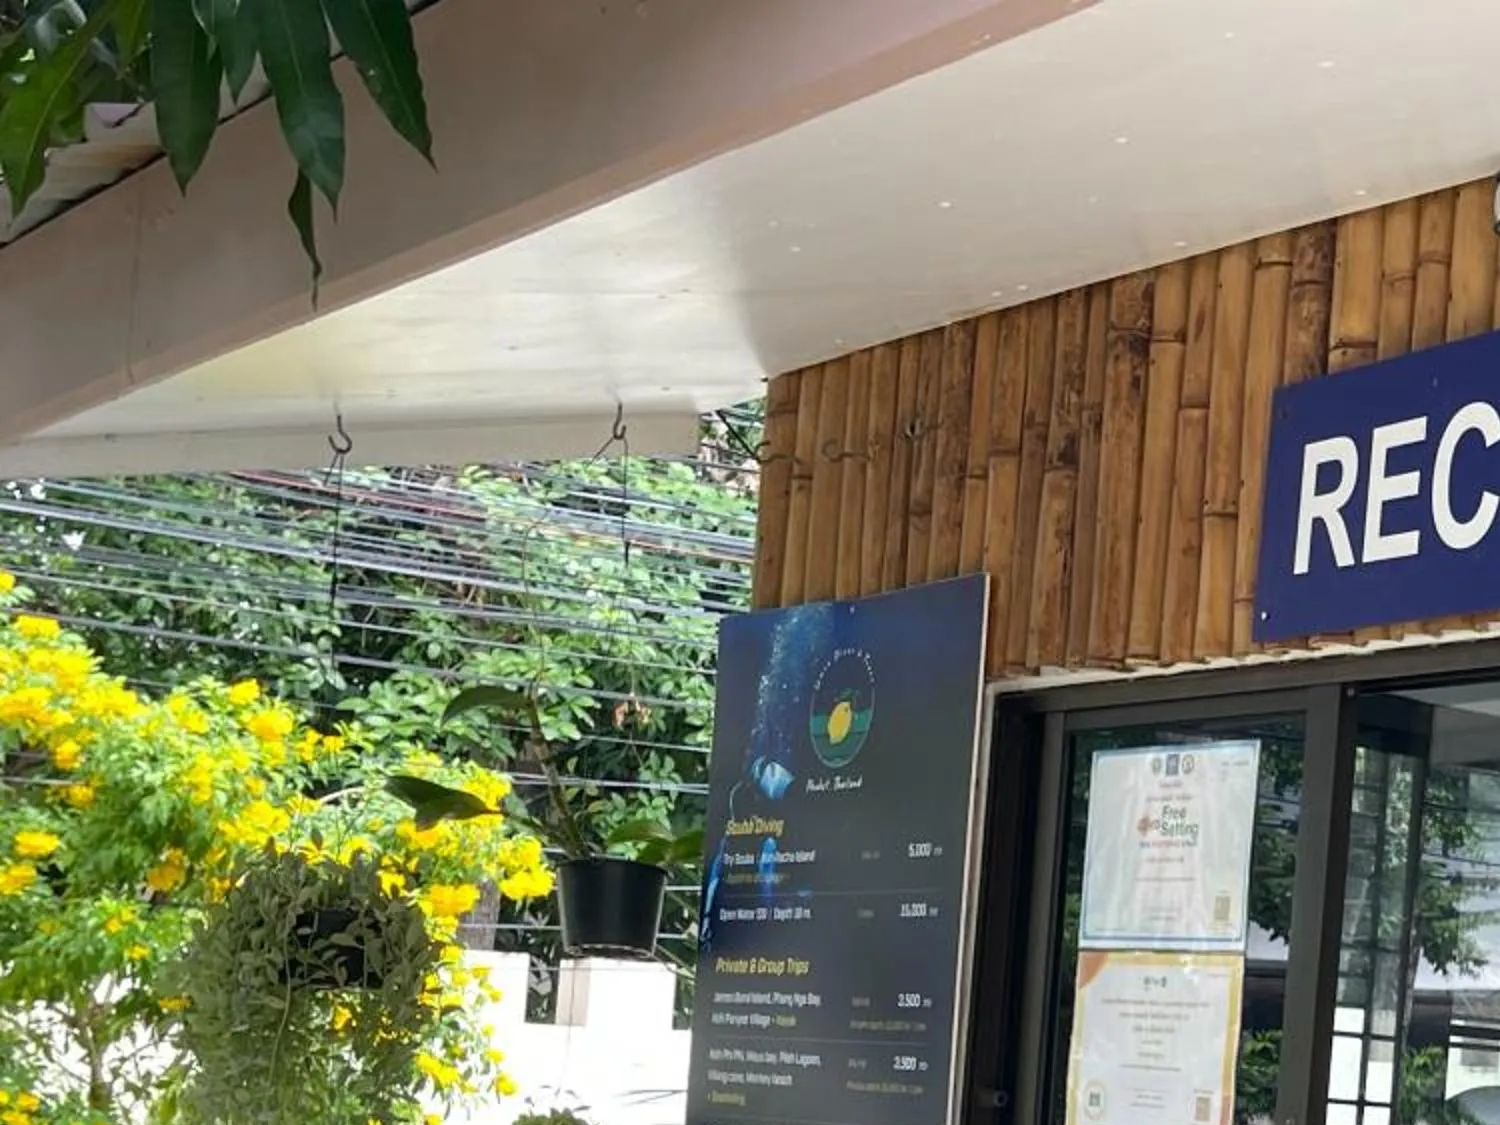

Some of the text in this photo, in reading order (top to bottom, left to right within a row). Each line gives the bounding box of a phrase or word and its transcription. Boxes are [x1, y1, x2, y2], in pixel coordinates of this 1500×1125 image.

[754, 817, 784, 837] Diving
[1160, 819, 1199, 840] Setting
[716, 956, 748, 974] Private
[757, 957, 785, 976] Group
[787, 957, 809, 976] Trips
